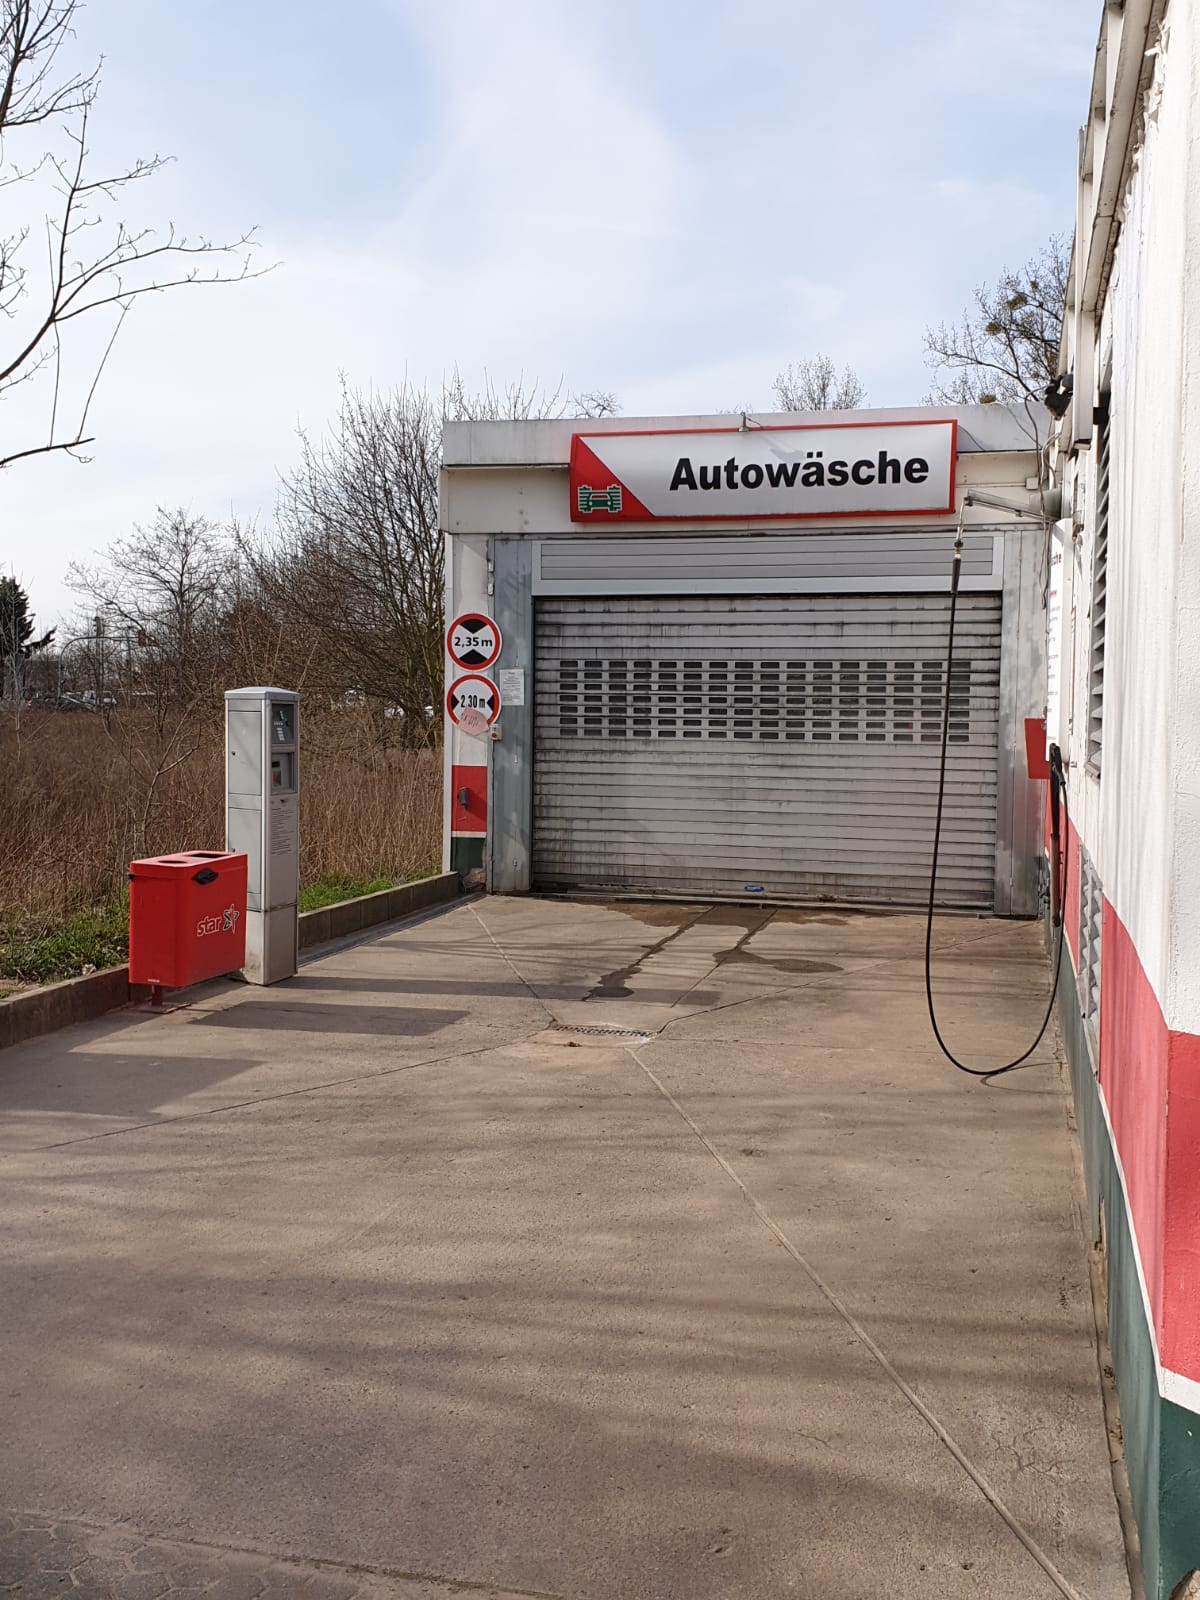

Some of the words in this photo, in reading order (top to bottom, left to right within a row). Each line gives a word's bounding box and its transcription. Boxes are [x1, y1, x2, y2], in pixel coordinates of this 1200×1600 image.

[669, 451, 929, 491] Autowäsche
[454, 637, 479, 648] 2,35
[460, 694, 478, 708] 230
[197, 915, 222, 937] star
